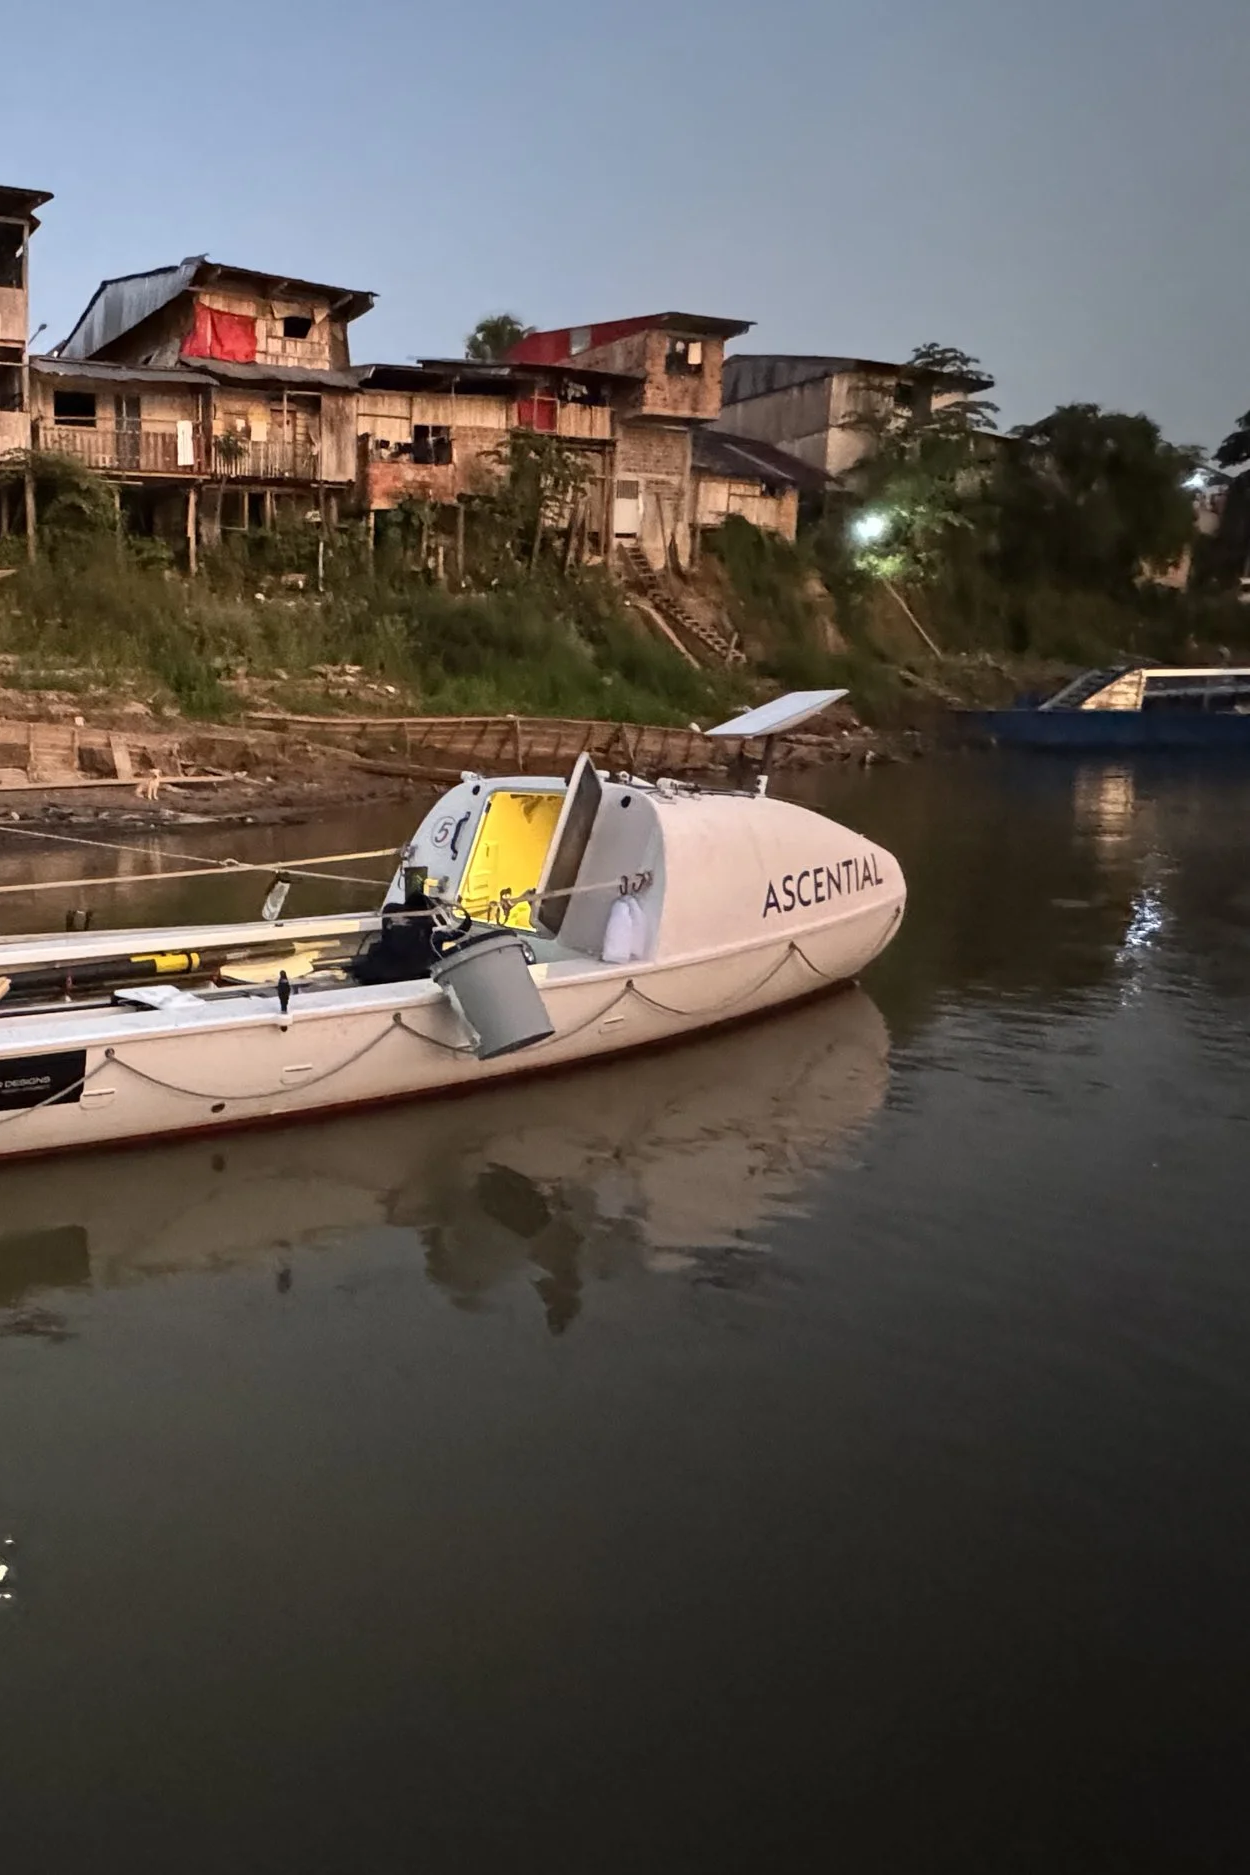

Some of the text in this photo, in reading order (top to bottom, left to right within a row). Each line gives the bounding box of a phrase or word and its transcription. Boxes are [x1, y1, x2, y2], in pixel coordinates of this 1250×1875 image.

[434, 821, 453, 844] 5
[762, 853, 884, 918] ASCENTIAL
[4, 1075, 51, 1089] DESIGNS
